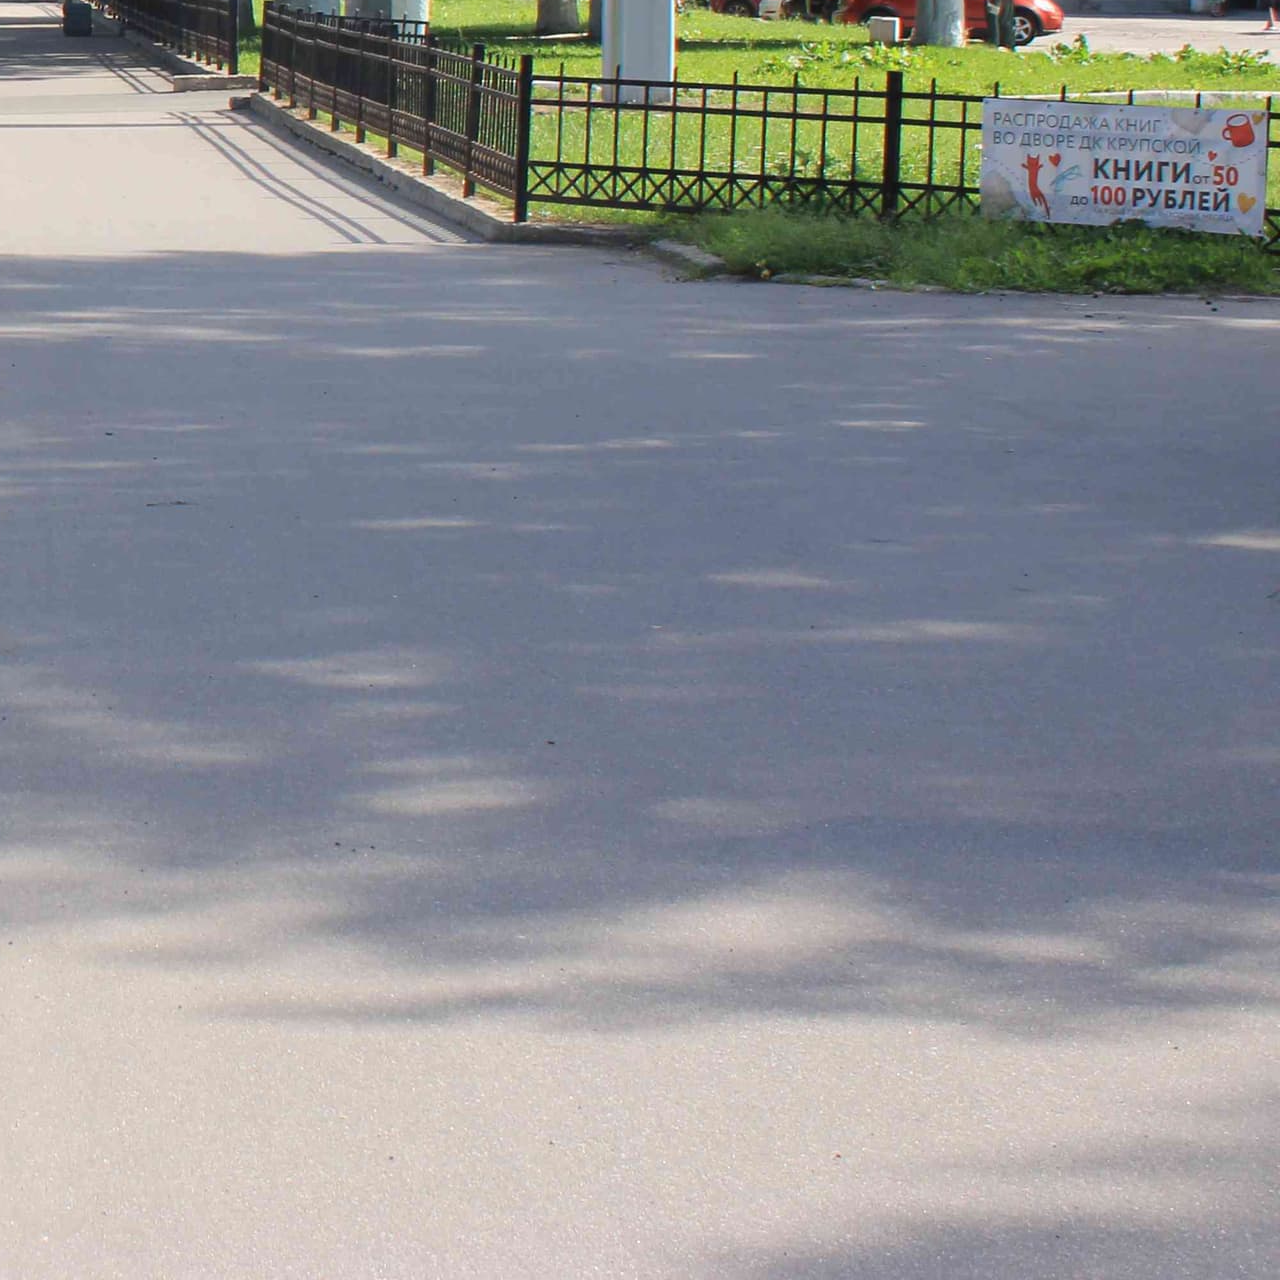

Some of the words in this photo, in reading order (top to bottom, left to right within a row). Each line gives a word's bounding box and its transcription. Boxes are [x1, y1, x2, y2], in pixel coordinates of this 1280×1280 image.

[993, 112, 1109, 131] РАСПРОДАЖА
[1115, 118, 1161, 134] КНИГ
[993, 130, 1016, 145] ВО
[1020, 132, 1075, 149] ДВОРЕ
[1079, 135, 1102, 150] ДК
[1107, 134, 1200, 155] КРУПСКОЙ
[1093, 158, 1190, 184] КНИГИ
[1192, 173, 1210, 185] от
[1213, 166, 1238, 186] 50
[1070, 195, 1088, 206] до
[1091, 186, 1126, 206] 100
[1132, 187, 1230, 213] РУБЛЕЙ
